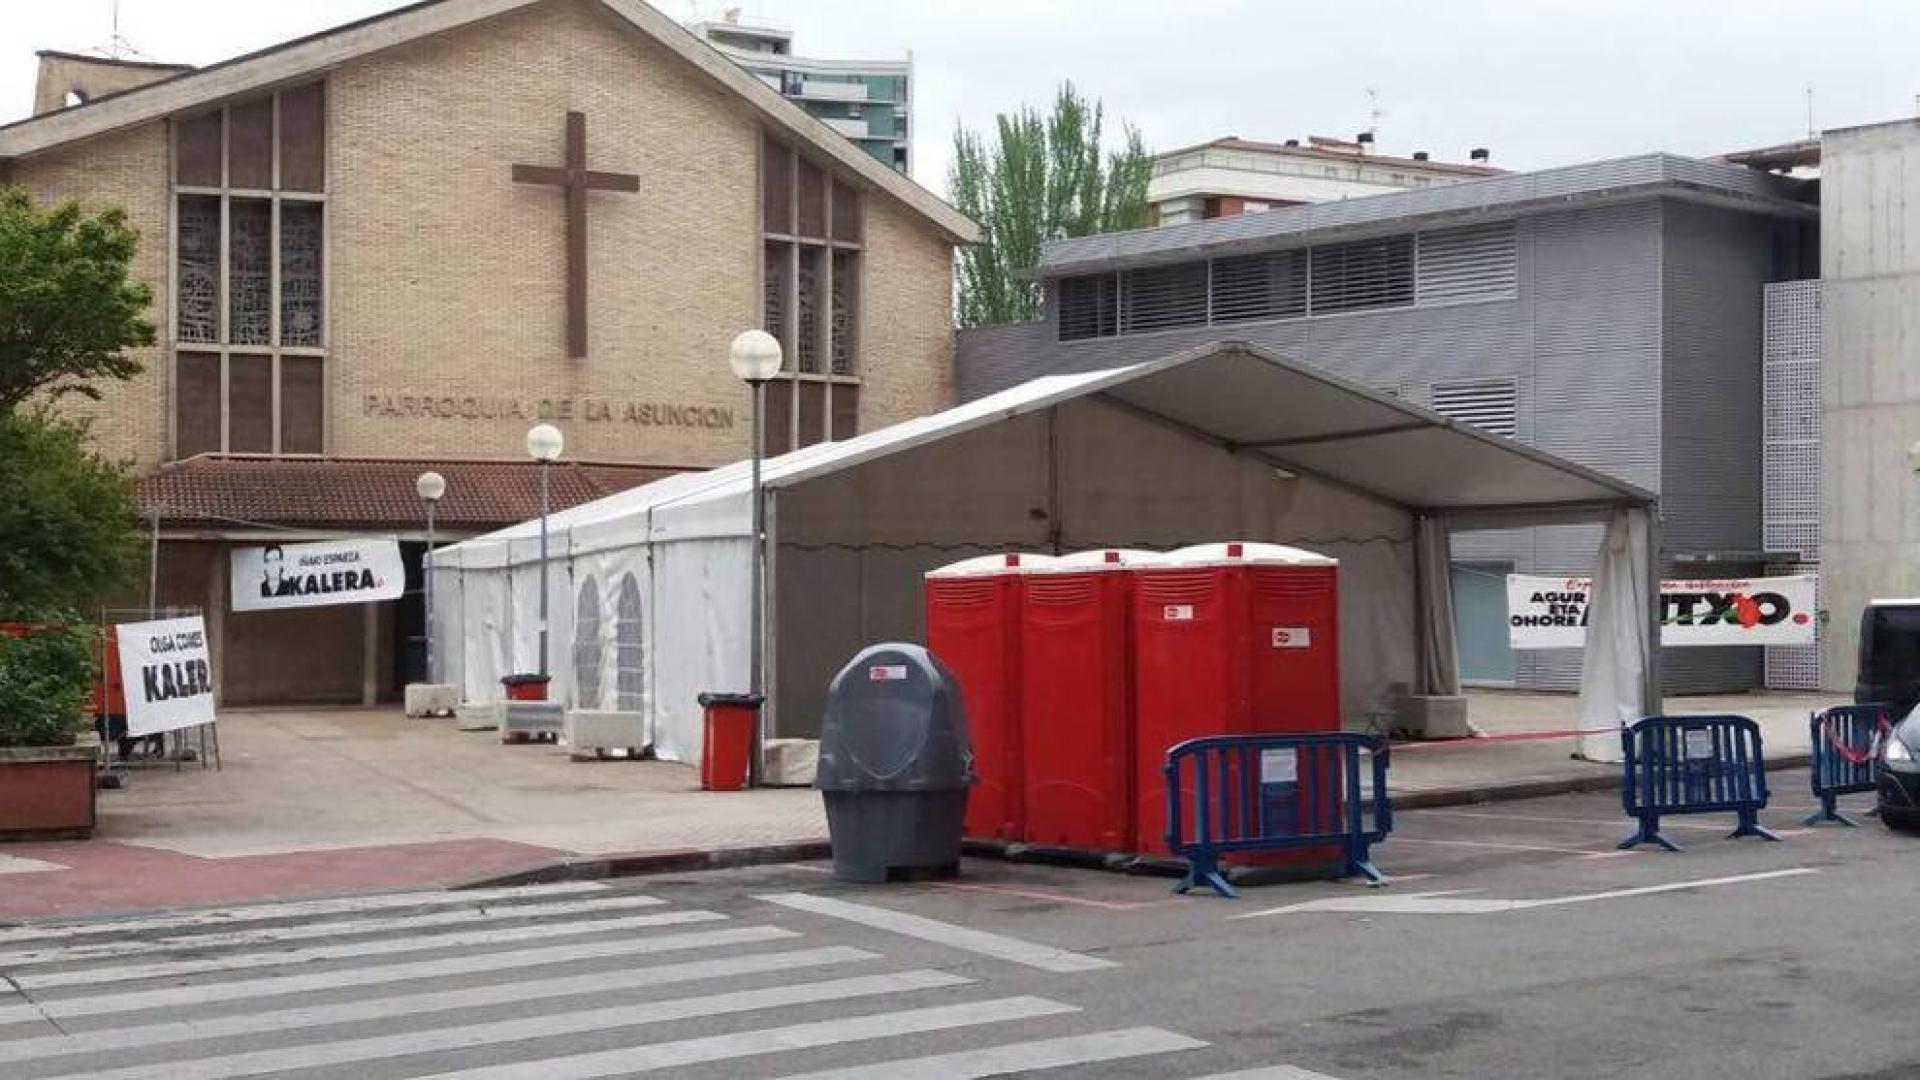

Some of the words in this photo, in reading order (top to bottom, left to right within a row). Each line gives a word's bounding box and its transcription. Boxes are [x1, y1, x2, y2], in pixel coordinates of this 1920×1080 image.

[363, 394, 526, 420] PARROQUIA
[537, 398, 573, 421] DE
[585, 400, 612, 422] LA
[622, 402, 735, 429] ASUNCION
[1530, 591, 1586, 604] AGUR
[1549, 604, 1581, 616] ETA
[1511, 614, 1577, 627] OHORE
